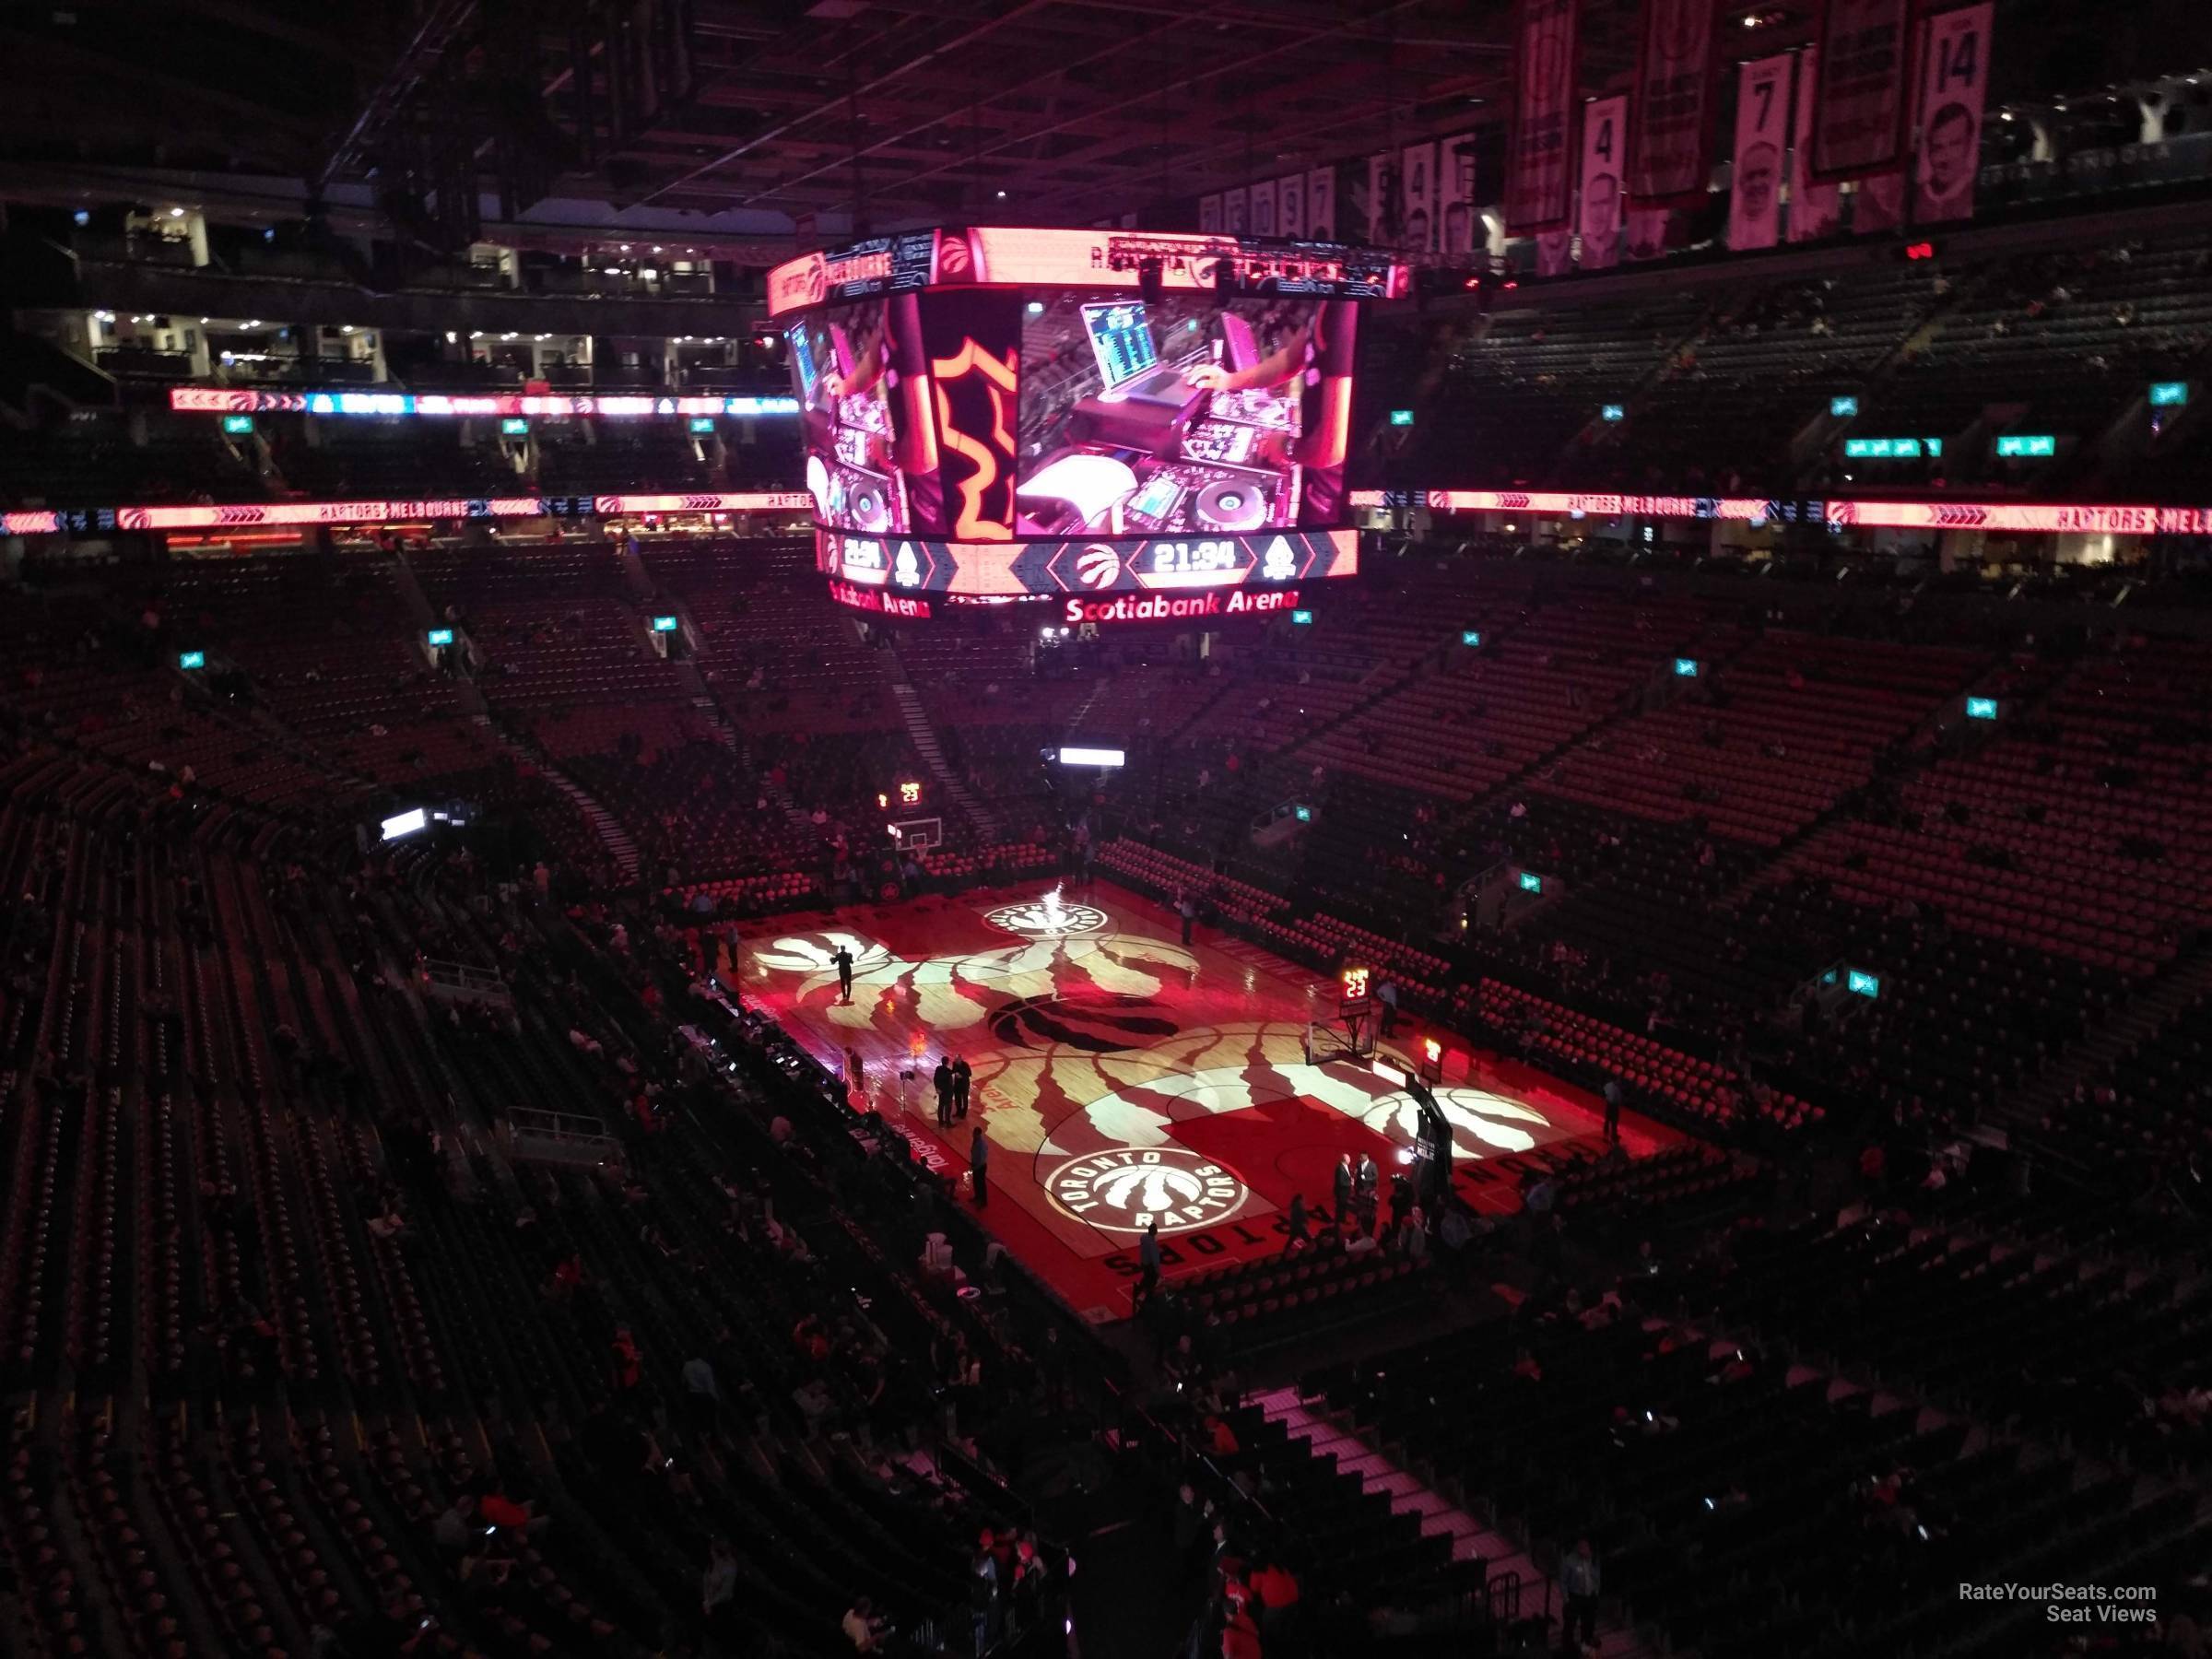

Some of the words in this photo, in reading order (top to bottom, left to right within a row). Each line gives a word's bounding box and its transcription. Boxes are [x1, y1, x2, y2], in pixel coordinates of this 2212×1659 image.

[1938, 31, 1979, 93] 14
[1755, 80, 1775, 133] 7
[1595, 119, 1611, 163] 4
[1411, 161, 1424, 201] 4
[1066, 593, 1220, 622] Scotiabank
[1227, 591, 1299, 613] Arena
[1346, 979, 1366, 998] 23
[1060, 1151, 1161, 1213] TORONTO
[1135, 1164, 1237, 1227] RAPTORS
